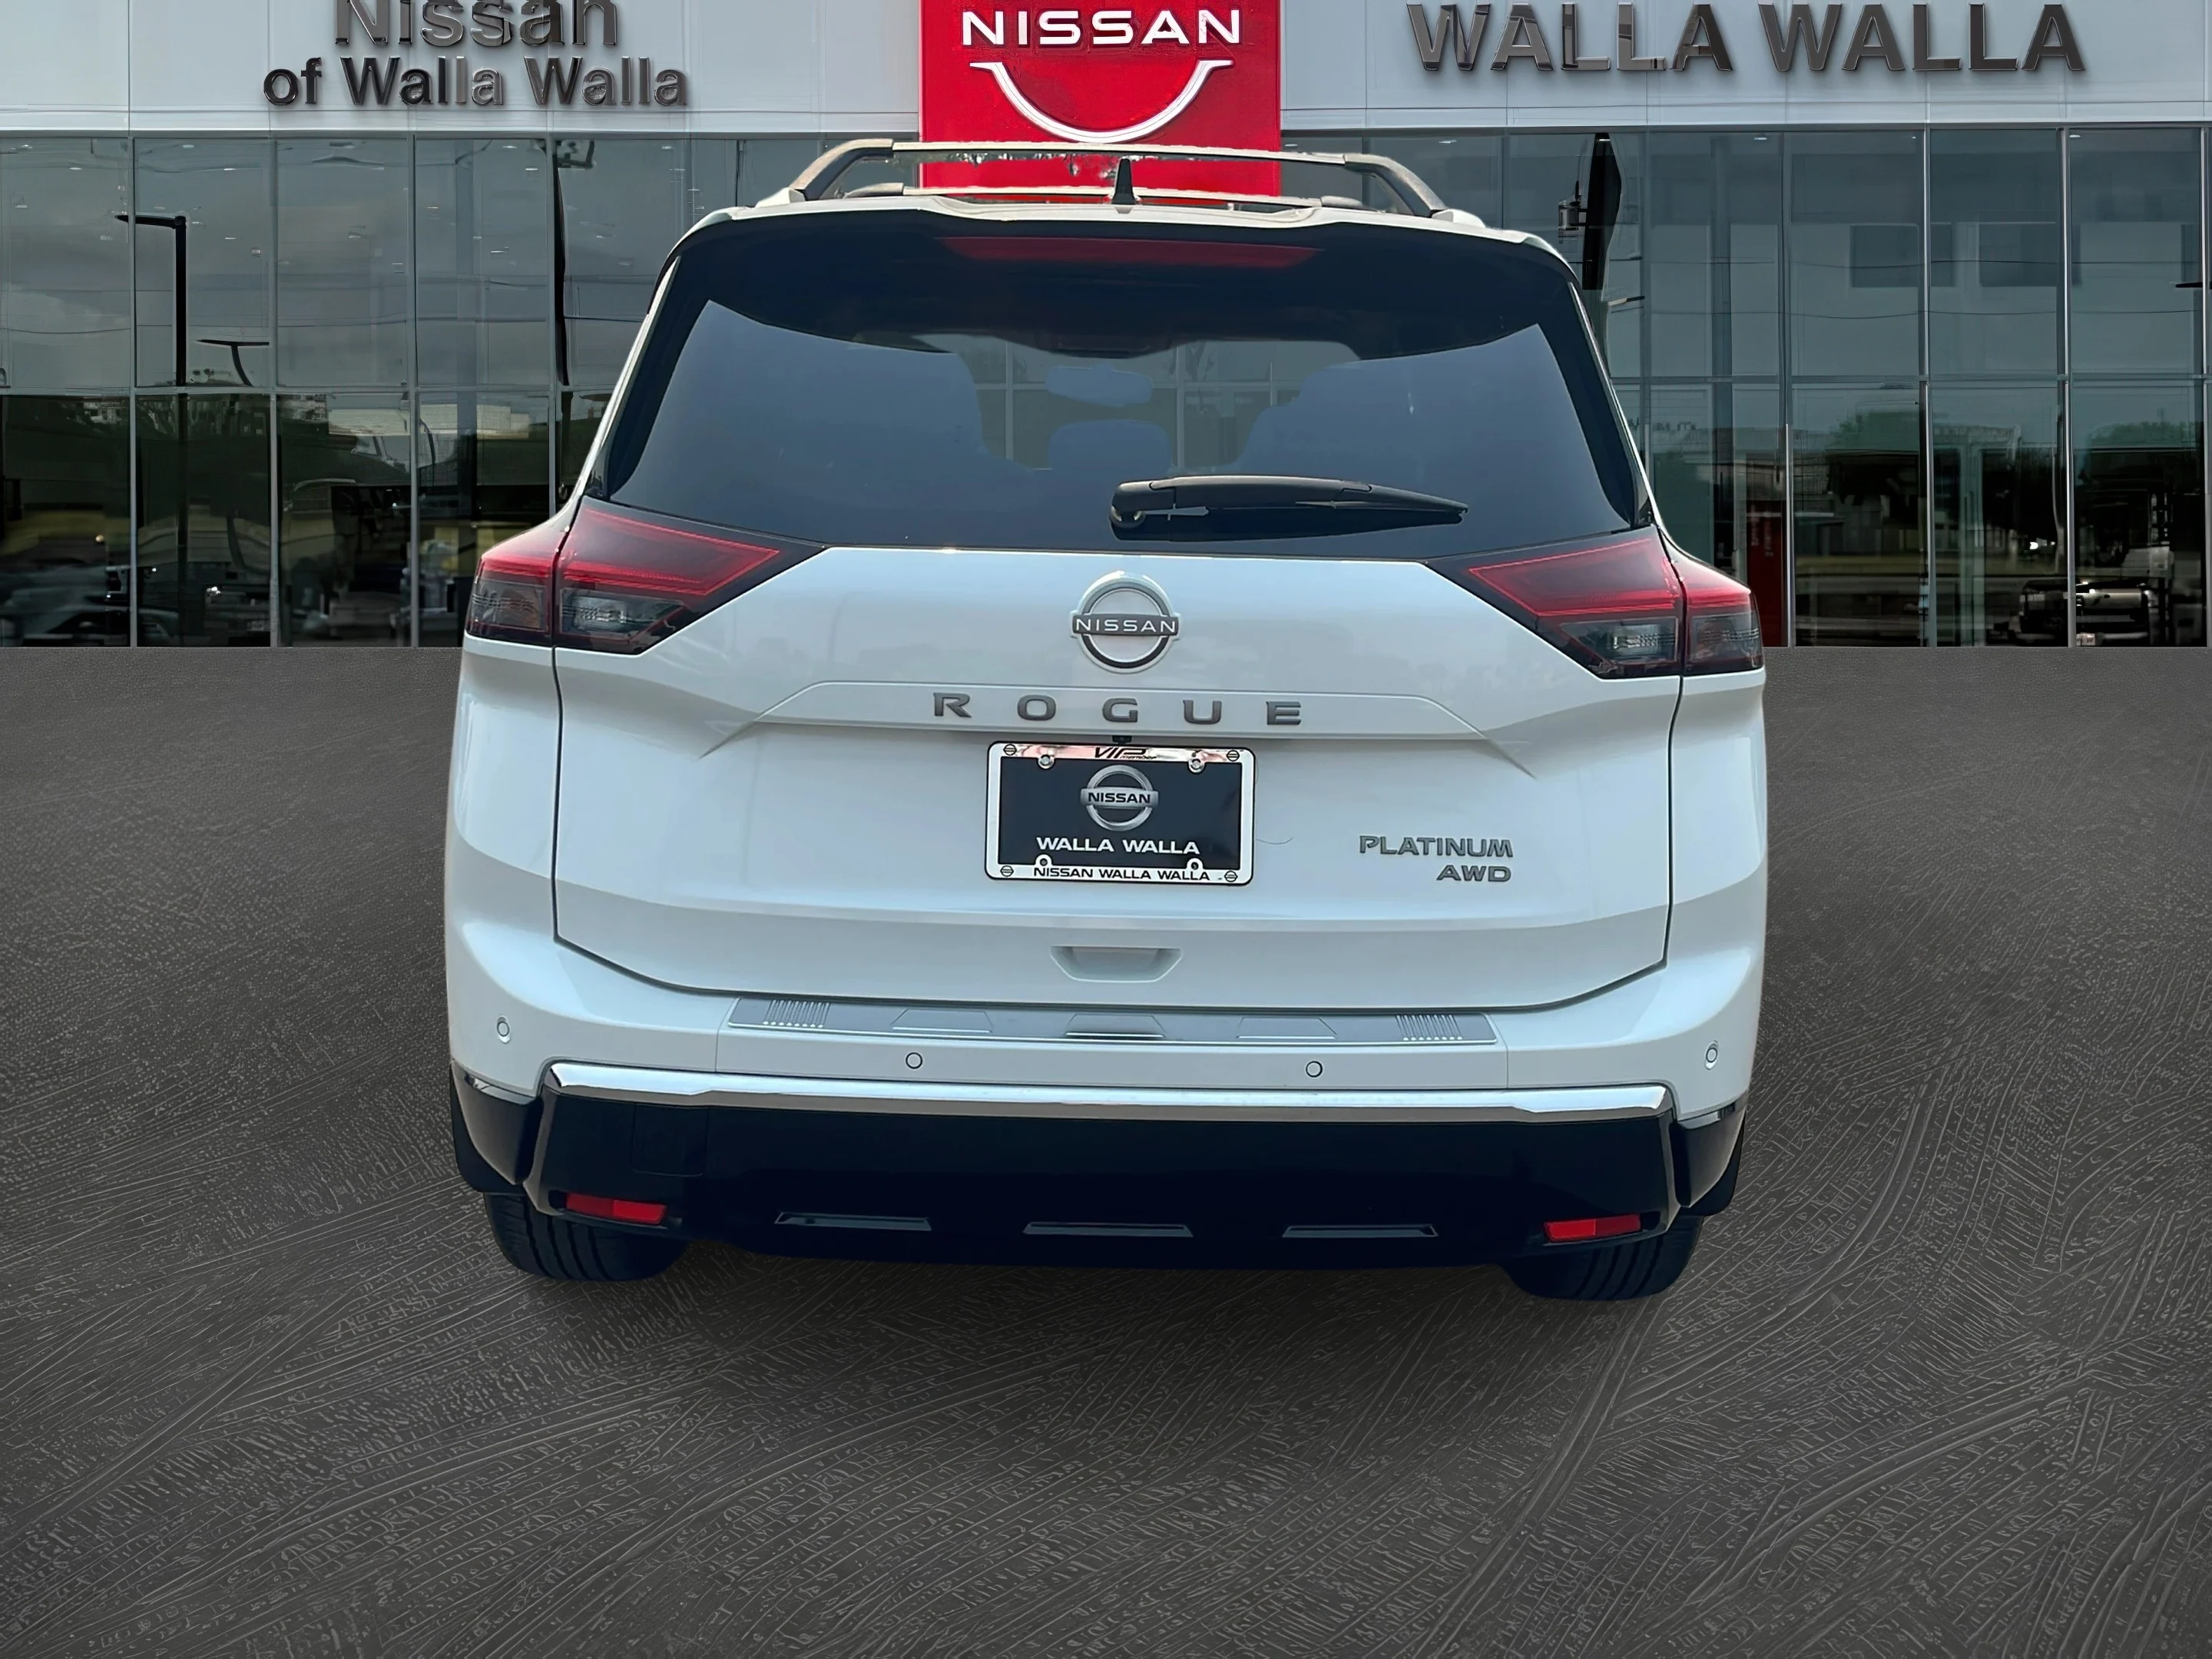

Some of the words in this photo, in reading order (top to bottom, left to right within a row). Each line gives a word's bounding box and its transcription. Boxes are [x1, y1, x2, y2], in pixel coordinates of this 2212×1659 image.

[334, 0, 618, 47] Nissan
[962, 9, 1240, 46] NISSAN
[1406, 2, 1734, 71] WALLA
[1757, 2, 2085, 71] WALLA
[263, 57, 323, 106] of
[339, 56, 503, 106] Walla
[523, 56, 688, 106] Walla
[1076, 618, 1176, 633] NISSAN
[933, 692, 1302, 726] ROGUE
[1094, 747, 1147, 759] VIP
[1088, 792, 1151, 804] NISSAN
[1037, 837, 1114, 853] WALLA
[1123, 839, 1200, 855] WALLA
[1359, 836, 1513, 857] PLATINUM
[1034, 868, 1093, 878] NISSAN
[1099, 869, 1152, 879] WALLA
[1157, 870, 1210, 881] WALLA
[1436, 865, 1512, 882] AWD
